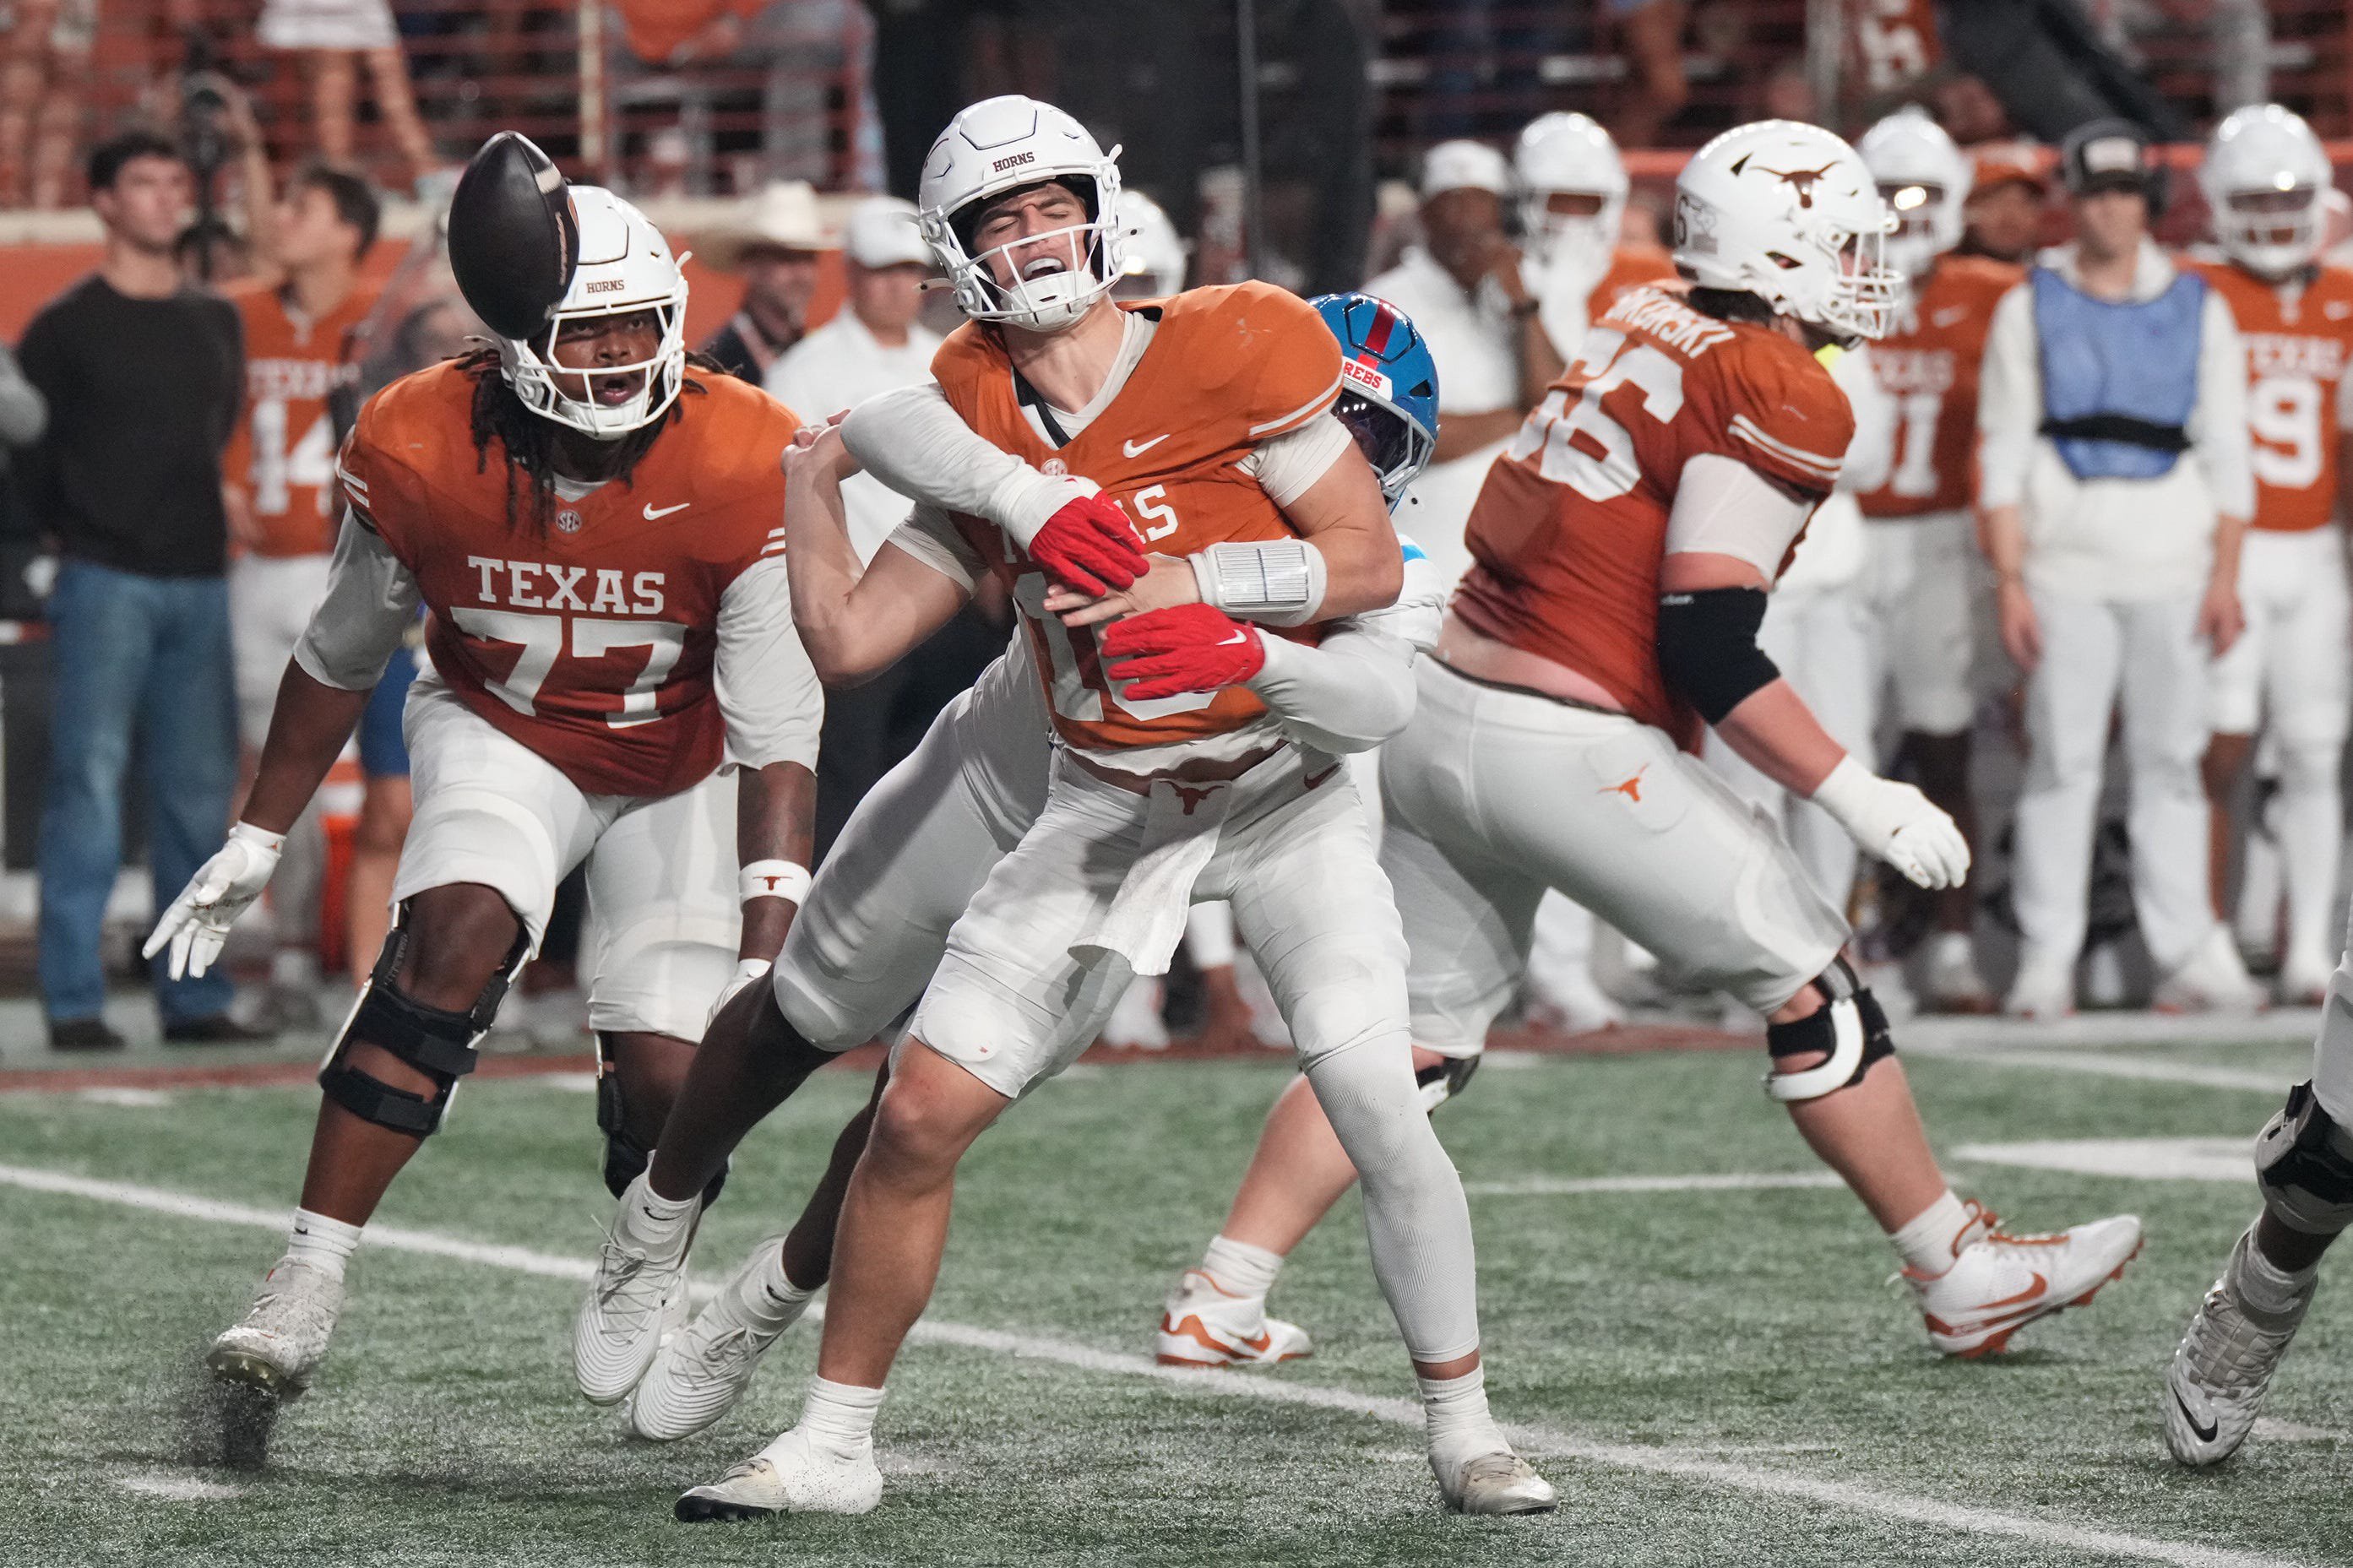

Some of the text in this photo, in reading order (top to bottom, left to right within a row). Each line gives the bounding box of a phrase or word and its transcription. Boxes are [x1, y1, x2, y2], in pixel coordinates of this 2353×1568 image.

[992, 151, 1035, 172] HORNS
[586, 279, 625, 294] HORNS
[1343, 361, 1383, 390] REBS
[558, 512, 580, 532] SEC
[467, 555, 666, 616] TEXAS
[449, 606, 689, 730] 77
